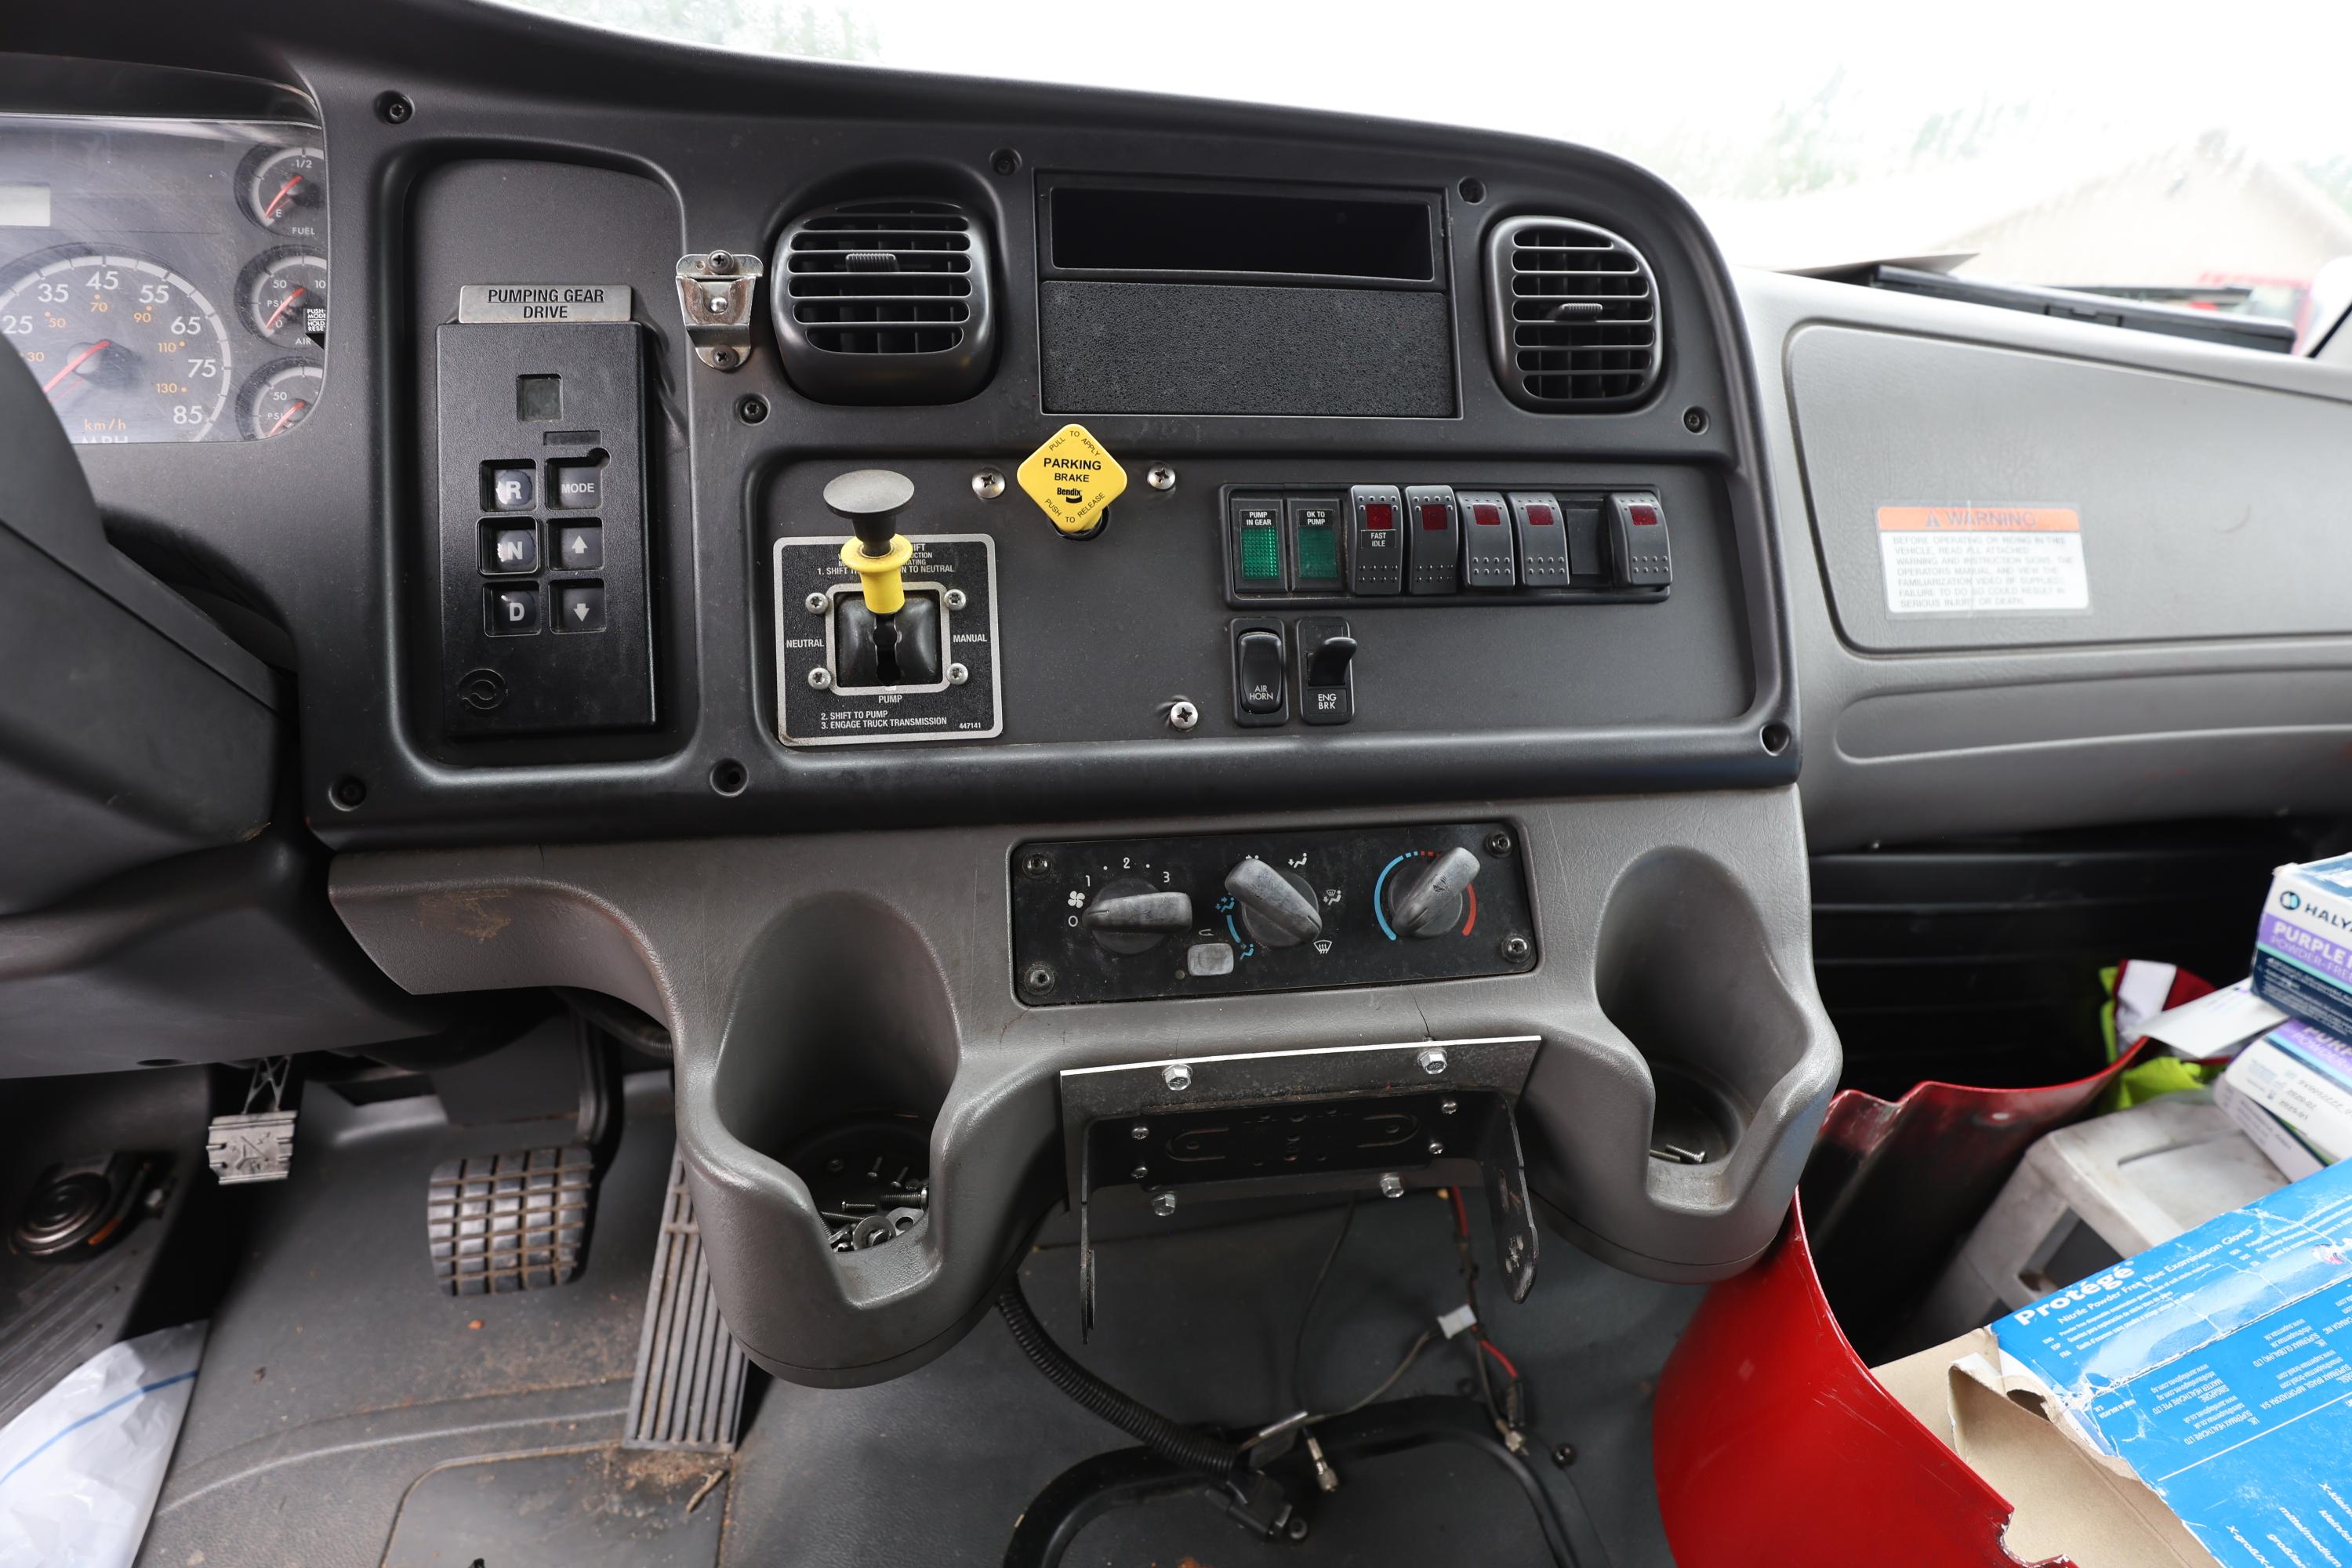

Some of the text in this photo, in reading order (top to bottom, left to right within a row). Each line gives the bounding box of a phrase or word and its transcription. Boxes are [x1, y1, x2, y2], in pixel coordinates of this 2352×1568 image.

[275, 209, 283, 217] E
[292, 227, 315, 235] FUEL
[85, 270, 119, 290] 45
[273, 279, 287, 289] 50
[38, 283, 69, 303] 35
[139, 285, 170, 304] 55
[488, 289, 604, 303] PUMPING GEAR
[90, 302, 108, 313] 70
[523, 306, 568, 318] DRIVE
[49, 318, 66, 328] 50
[133, 311, 151, 323] 90
[2, 315, 33, 334] 25
[170, 314, 201, 334] 65
[158, 342, 176, 353] 110
[27, 351, 45, 362] 30
[187, 358, 216, 378] 75
[156, 383, 177, 394] 130
[273, 391, 288, 401] 50
[172, 405, 203, 424] 85
[84, 419, 126, 431] km/h
[1049, 437, 1065, 451] PULL
[1081, 437, 1101, 456] APPLY
[1044, 457, 1102, 470] PARKING
[1054, 473, 1090, 483] BRAKE
[506, 481, 522, 499] R
[561, 482, 595, 493] MODE
[1057, 487, 1081, 497] Bendix
[1044, 498, 1062, 517] PUSH
[1077, 492, 1105, 517] RELEASE
[1945, 511, 2037, 528] WARNING
[507, 541, 523, 560] N
[817, 567, 825, 575] 1.
[920, 564, 955, 573] NEUTRAL
[509, 603, 525, 622] D
[786, 638, 825, 648] NEUTRAL
[953, 633, 988, 643] MANUAL
[878, 695, 902, 703] PUMP
[821, 712, 828, 720] 2.
[829, 711, 852, 720] SHIFT
[866, 710, 888, 719] PUMP
[821, 717, 947, 730] 3. ENGAGE TRUCK TRANSMISSION
[1123, 857, 1131, 869] 2
[1085, 875, 1091, 887] 1
[1163, 871, 1171, 883] 3
[2305, 903, 2352, 932] HALY
[2274, 920, 2347, 966] PURPLE
[2057, 1307, 2088, 1324] Nitrile
[2086, 1291, 2121, 1310] Powder
[2142, 1270, 2165, 1283] Blue
[2164, 1244, 2223, 1272] Examination
[2221, 1228, 2254, 1245] Gloves
[2013, 1265, 2135, 1326] Protégé
